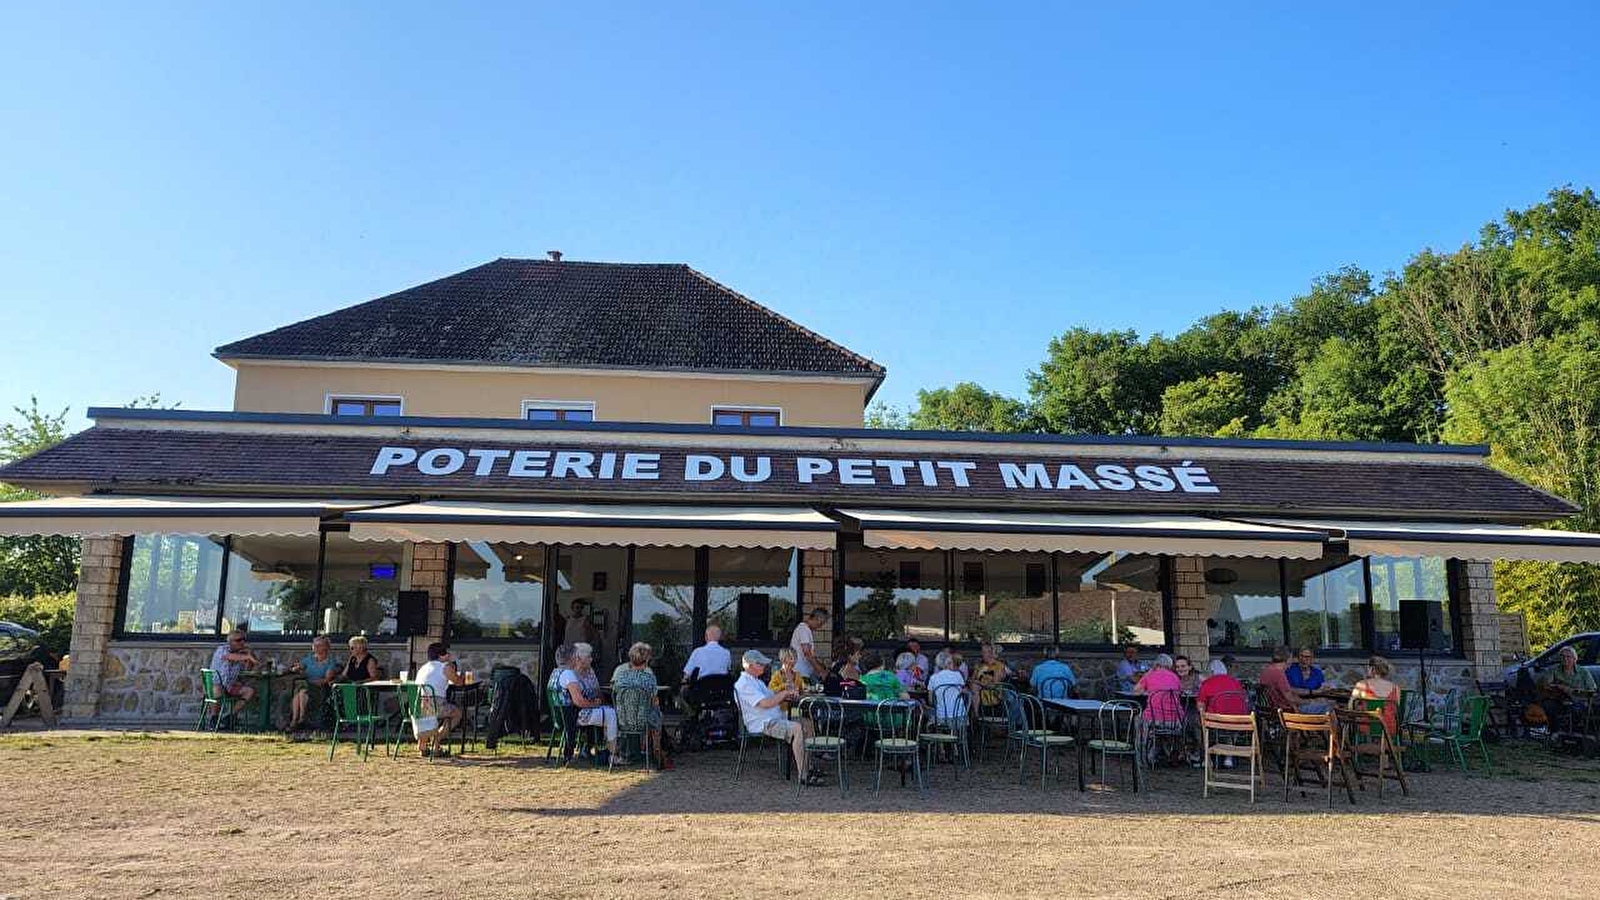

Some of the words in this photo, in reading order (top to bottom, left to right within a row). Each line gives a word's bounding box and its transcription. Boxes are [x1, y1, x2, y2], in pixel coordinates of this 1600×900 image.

[370, 447, 661, 480] POTERIE
[685, 455, 771, 482] DU
[796, 457, 977, 487] PETIT
[999, 460, 1220, 493] MASSÉ
